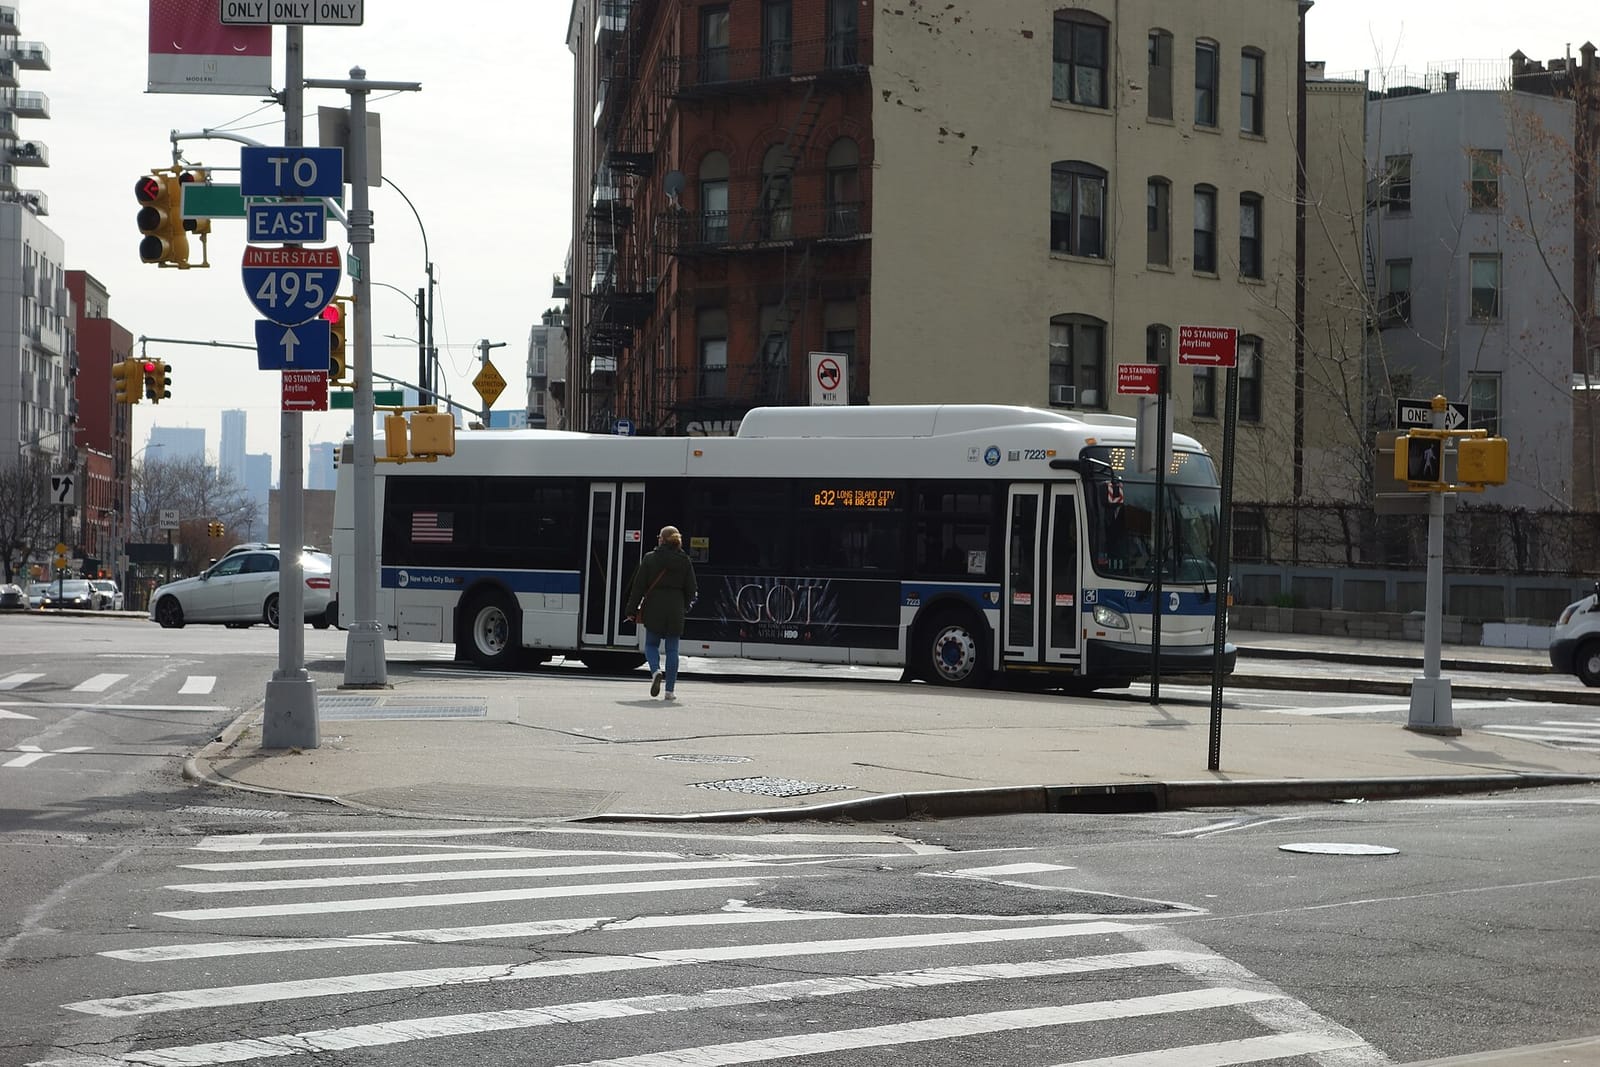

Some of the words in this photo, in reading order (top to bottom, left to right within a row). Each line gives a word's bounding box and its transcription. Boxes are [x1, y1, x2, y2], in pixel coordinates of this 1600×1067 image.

[228, 2, 263, 17] ONLY
[274, 3, 309, 18] ONLY
[321, 3, 356, 19] ONLY
[267, 157, 318, 187] TO
[255, 211, 318, 234] EAST
[249, 251, 333, 264] INTERSTATE
[256, 271, 324, 309] 495
[1182, 329, 1192, 338] NO
[1193, 331, 1229, 339] STANDING
[1182, 338, 1211, 348] Anytime
[284, 374, 292, 383] NO
[293, 374, 321, 383] STANDING
[1119, 374, 1142, 382] Anytime
[284, 383, 308, 392] Anytime
[823, 392, 837, 400] WITH
[1408, 408, 1428, 422] ONE
[1445, 412, 1458, 425] AY
[1024, 449, 1046, 460] 7223
[814, 490, 836, 505] B32
[836, 490, 853, 499] LONG
[854, 490, 878, 499] ISLAND
[879, 490, 895, 499] CITY
[843, 498, 853, 506] 44
[877, 498, 888, 506] ST
[165, 511, 174, 519] NO
[409, 575, 421, 583] New
[421, 575, 433, 583] York
[433, 575, 444, 585] City
[1123, 590, 1137, 598] 7223
[737, 583, 823, 625] GOT
[783, 630, 799, 639] HBO
